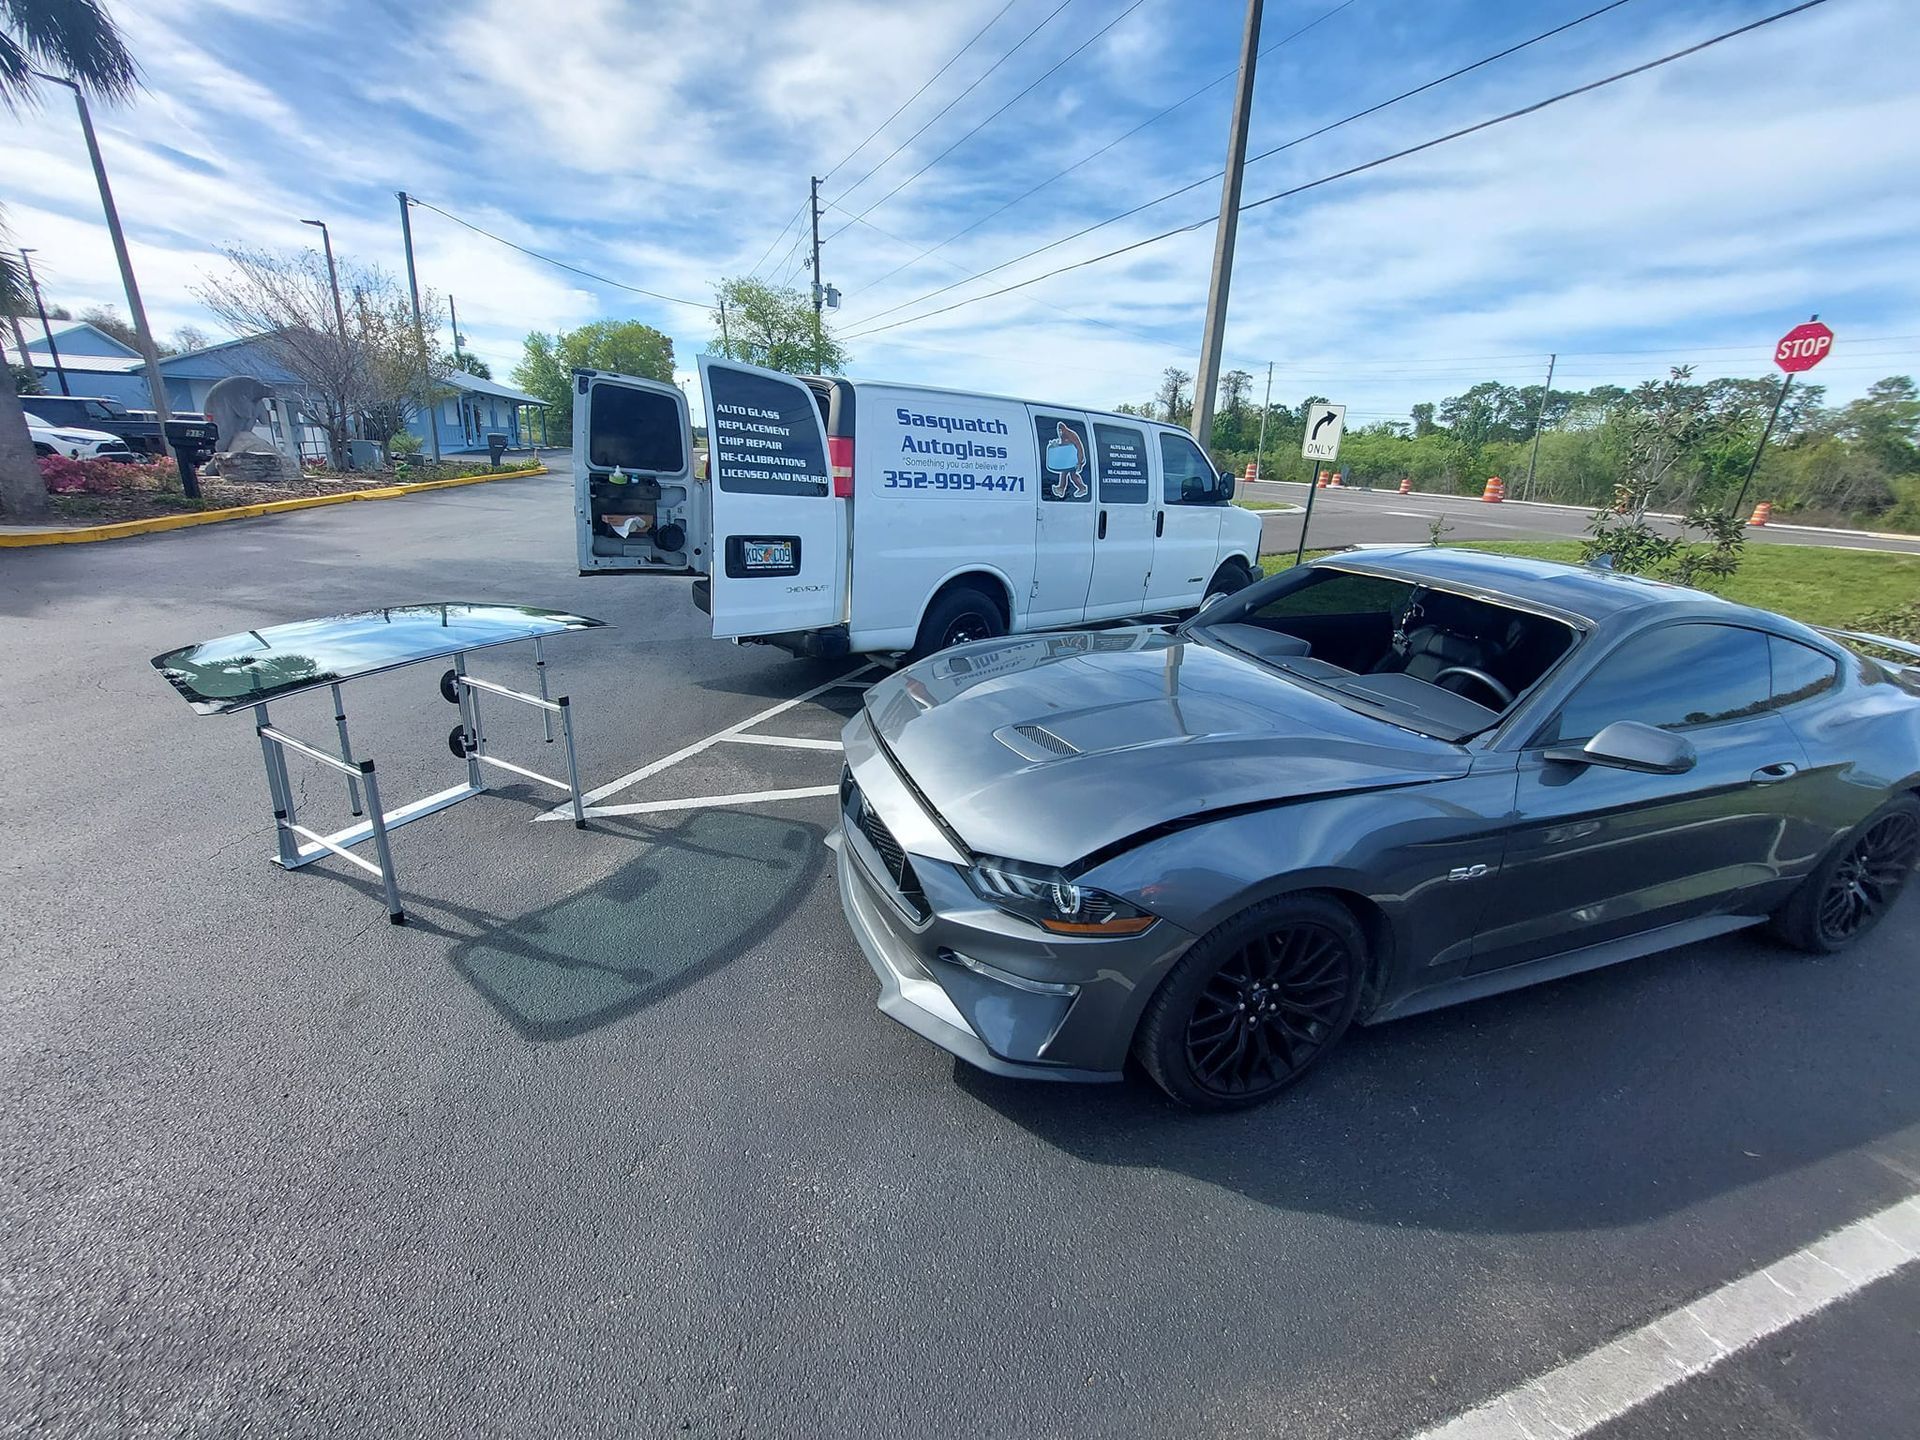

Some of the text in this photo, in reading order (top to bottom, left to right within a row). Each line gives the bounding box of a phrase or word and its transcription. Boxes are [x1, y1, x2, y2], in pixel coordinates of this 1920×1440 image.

[1777, 336, 1830, 360] STOP
[717, 404, 780, 420] AUTO GLASS
[718, 420, 790, 436] REPLACEMENT
[896, 408, 1008, 435] Sasquatch
[719, 436, 782, 450] CHIP REPAIR
[901, 435, 1008, 460] Autoglass
[1307, 443, 1334, 455] ONLY
[720, 452, 806, 468] RE-CALIBRATIONS
[946, 460, 960, 470] you
[961, 461, 973, 469] can
[975, 462, 997, 471] believe
[721, 469, 828, 484] LICENSED AND INSURED
[883, 470, 1025, 492] 352-999-4471
